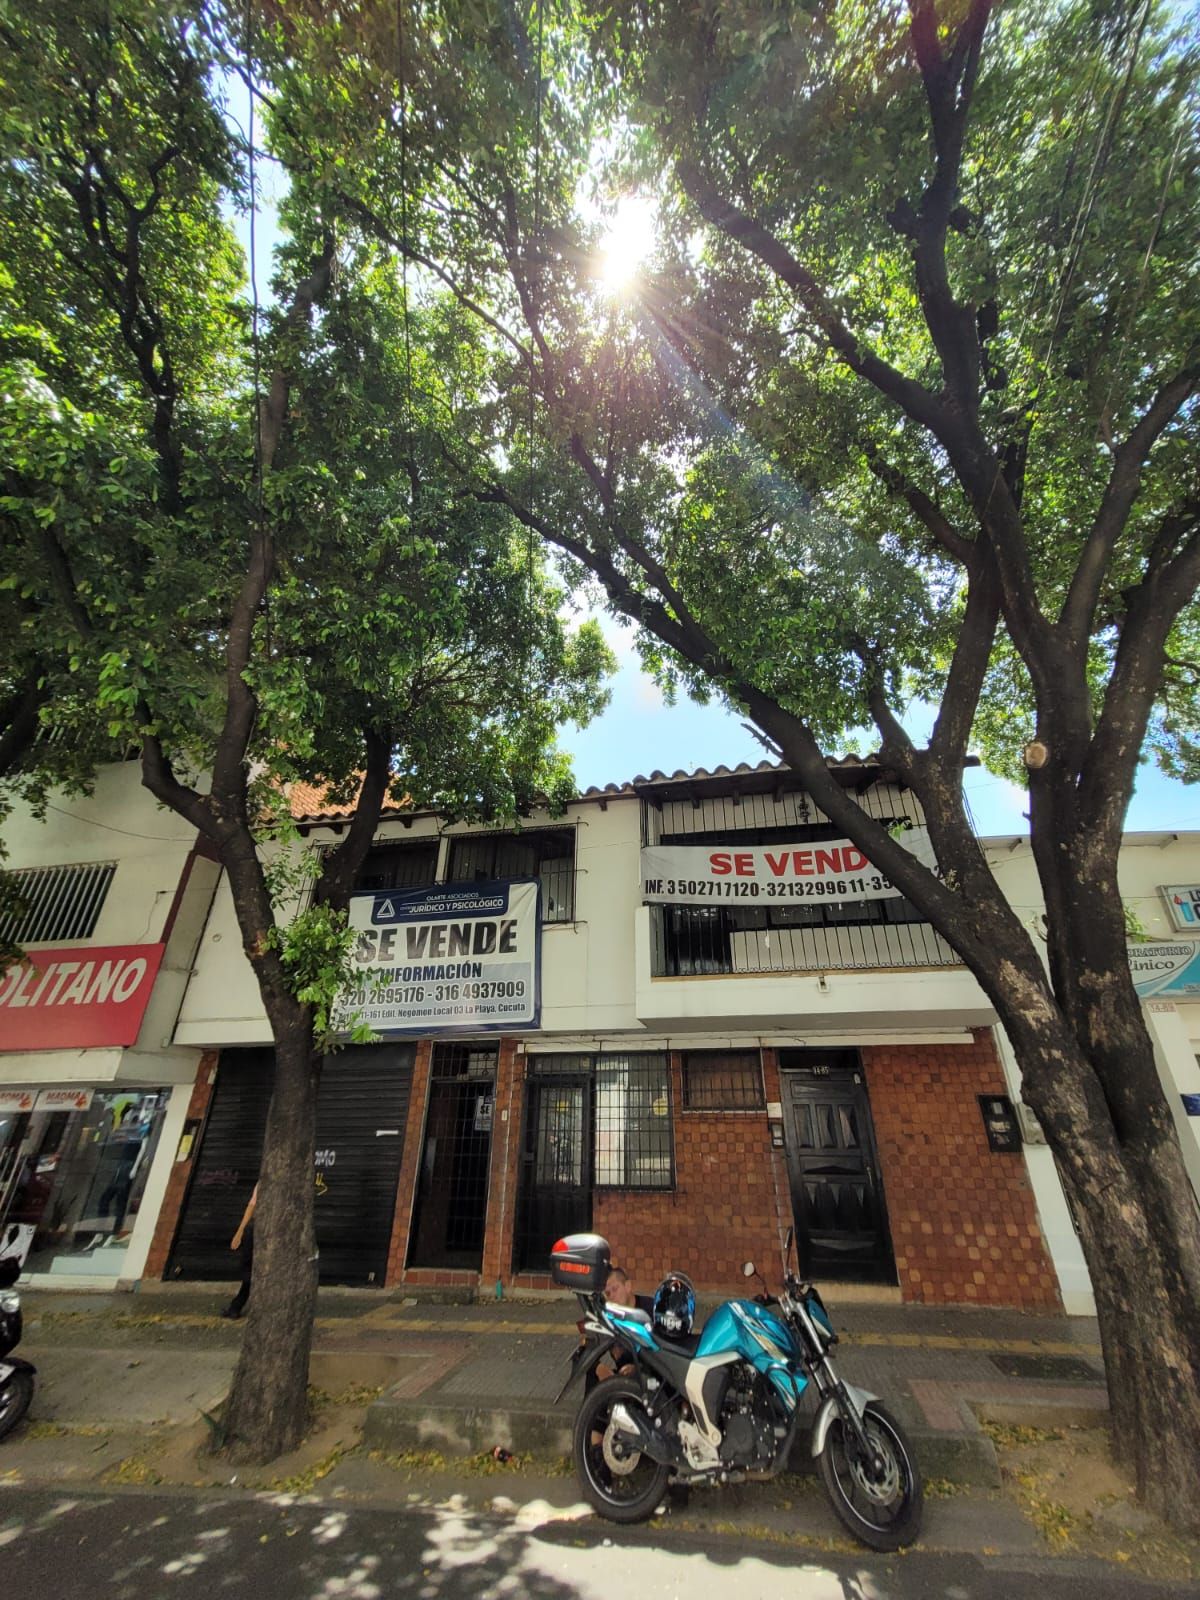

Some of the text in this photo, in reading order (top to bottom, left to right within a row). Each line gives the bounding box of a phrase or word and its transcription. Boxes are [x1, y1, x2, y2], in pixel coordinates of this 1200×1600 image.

[709, 846, 869, 876] SE VEND
[645, 880, 664, 894] INF.
[447, 892, 479, 900] ASOCIADOS
[409, 902, 444, 913] JURÍDICO
[452, 898, 503, 910] PSICOLÓGICO
[355, 920, 518, 963] SE VENDE
[368, 987, 424, 1004] 2695176
[435, 984, 459, 1001] 316
[463, 981, 524, 999] 4937909
[433, 1006, 452, 1015] Local
[465, 1005, 473, 1013] La
